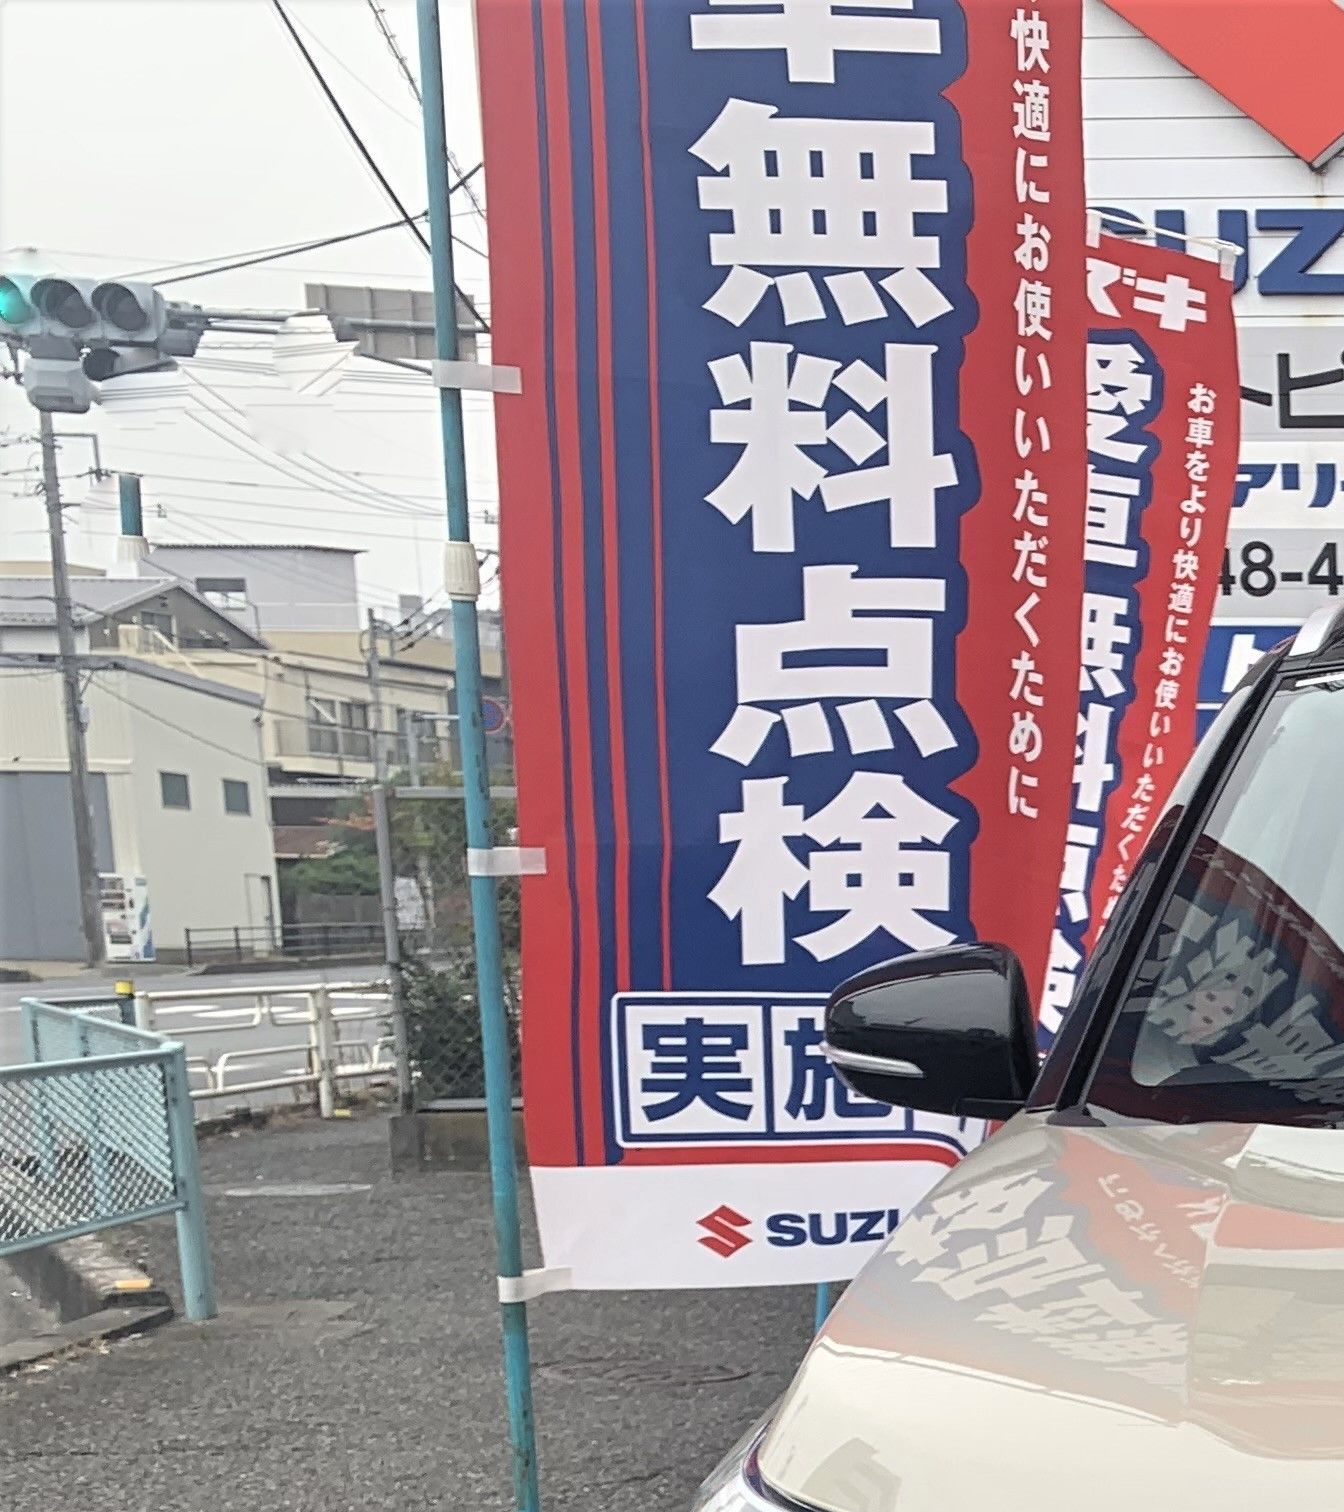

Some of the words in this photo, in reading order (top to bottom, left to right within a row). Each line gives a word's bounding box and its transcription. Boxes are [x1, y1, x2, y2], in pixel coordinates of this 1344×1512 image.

[1006, 0, 1053, 819] 快適にお使いいただくために
[1096, 382, 1218, 941] お車をより快適にお使いいただくた
